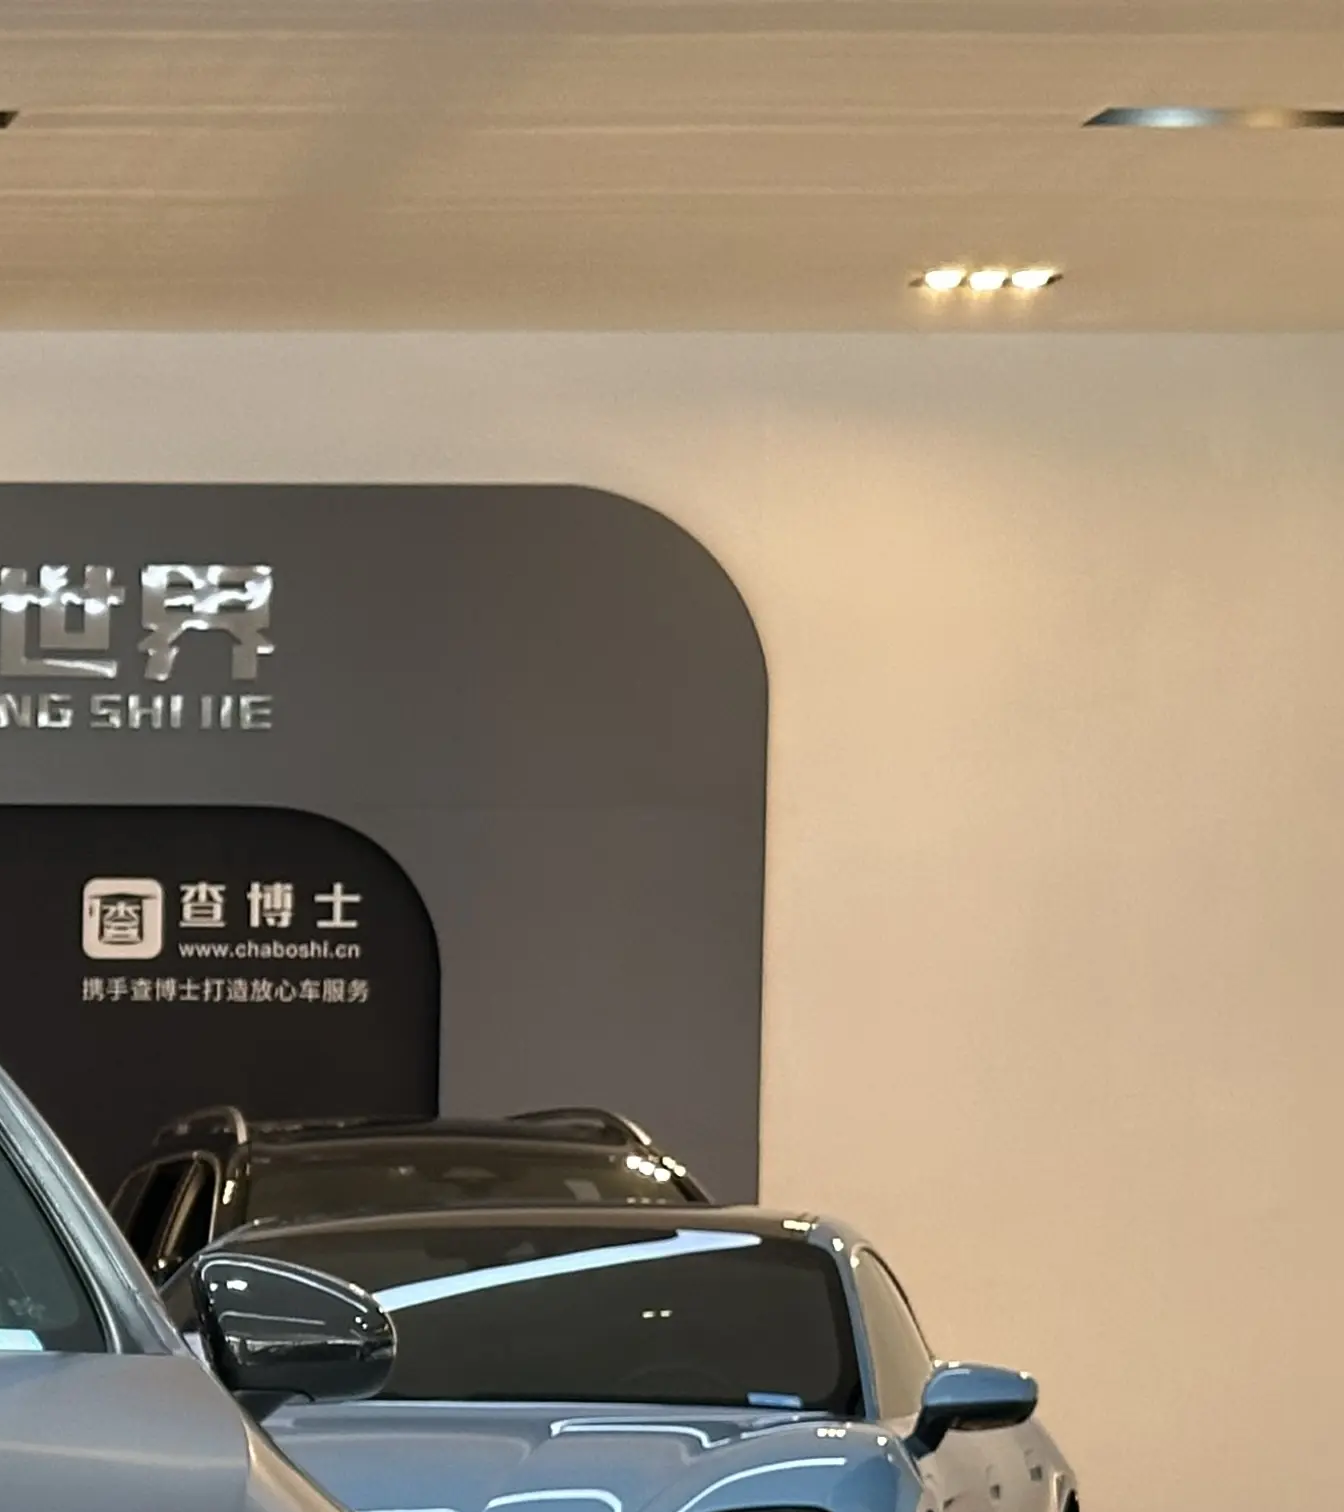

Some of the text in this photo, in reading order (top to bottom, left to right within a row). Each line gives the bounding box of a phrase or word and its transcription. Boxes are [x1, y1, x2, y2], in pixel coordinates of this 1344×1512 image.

[90, 694, 185, 730] SHI
[178, 881, 362, 928] 查博士
[179, 940, 361, 959] www.chaboshi.cn
[81, 977, 370, 1003] 携手查博士打造放心车服务
